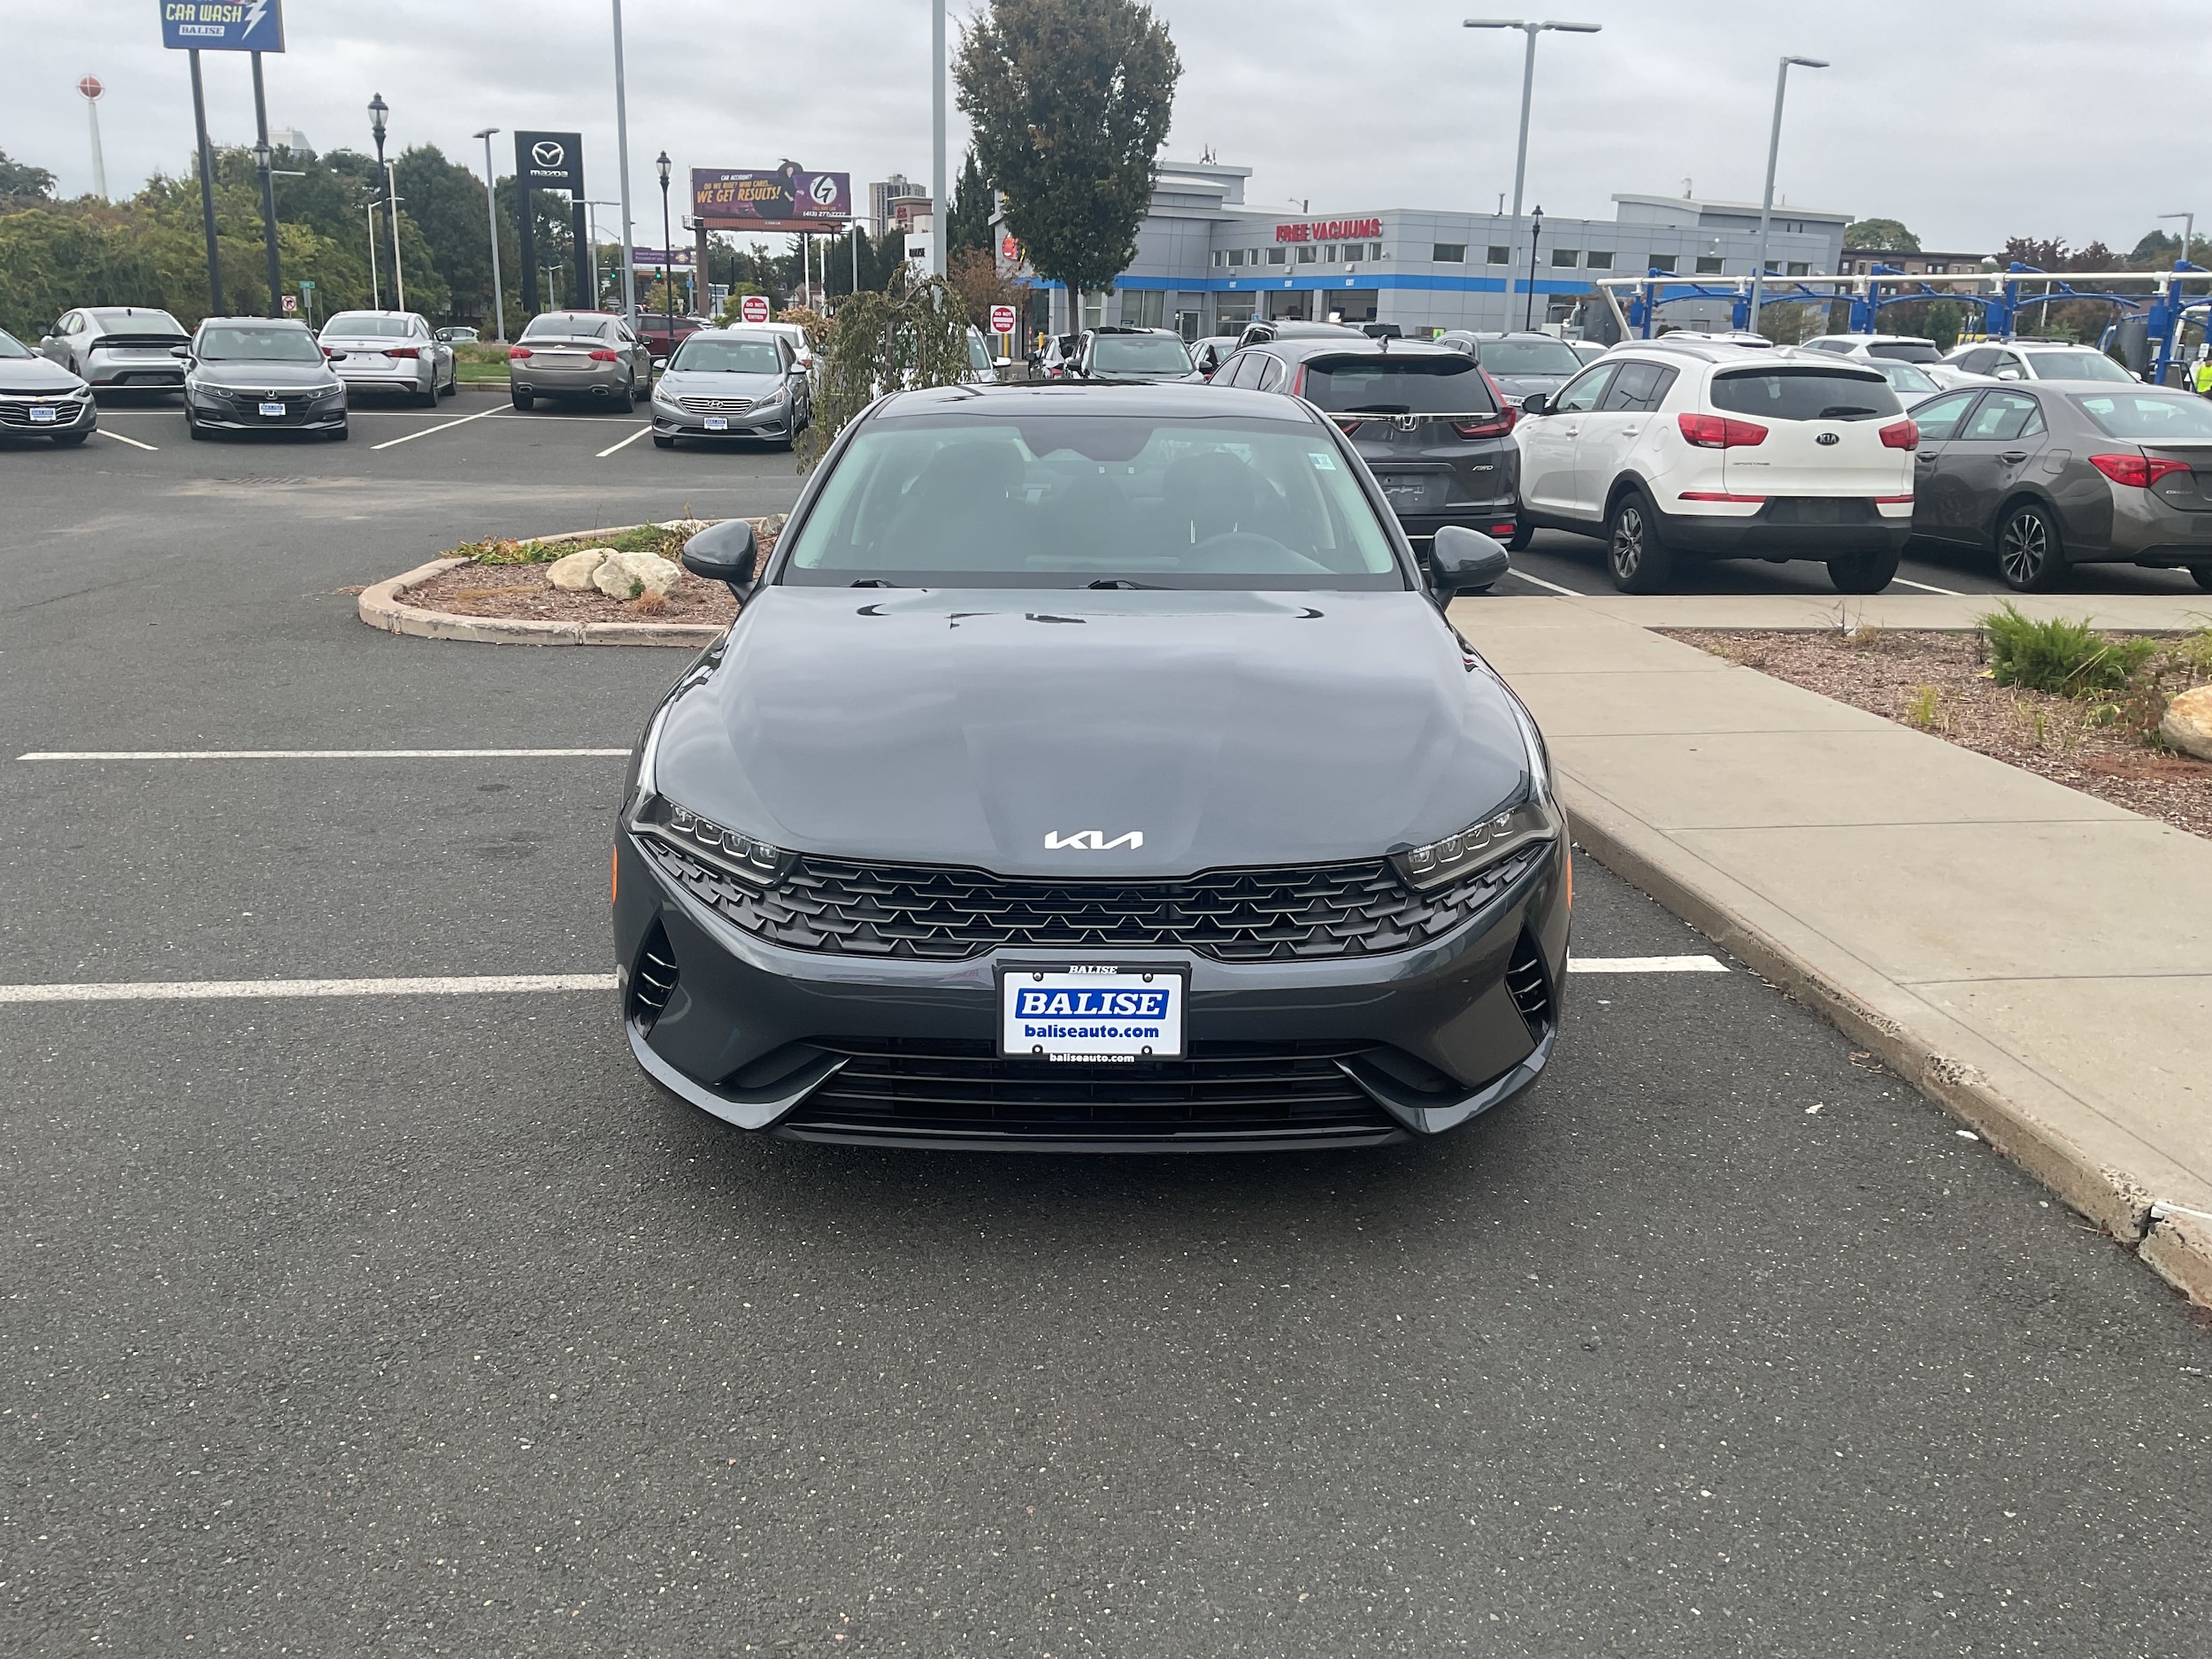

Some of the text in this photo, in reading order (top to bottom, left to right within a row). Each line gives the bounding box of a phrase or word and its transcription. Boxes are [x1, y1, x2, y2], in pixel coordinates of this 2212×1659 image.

[165, 4, 242, 22] CAR WASH
[697, 186, 781, 204] WE GET RESULTS!
[1276, 219, 1381, 242] FREE VACUUMS
[1819, 434, 1838, 443] KIA
[1044, 830, 1143, 850] KIA
[1068, 964, 1118, 974] BALISE
[1021, 992, 1163, 1016] BALISE
[1024, 1024, 1159, 1038] baliseauto.com
[1049, 1053, 1135, 1063] baliseauto.com
